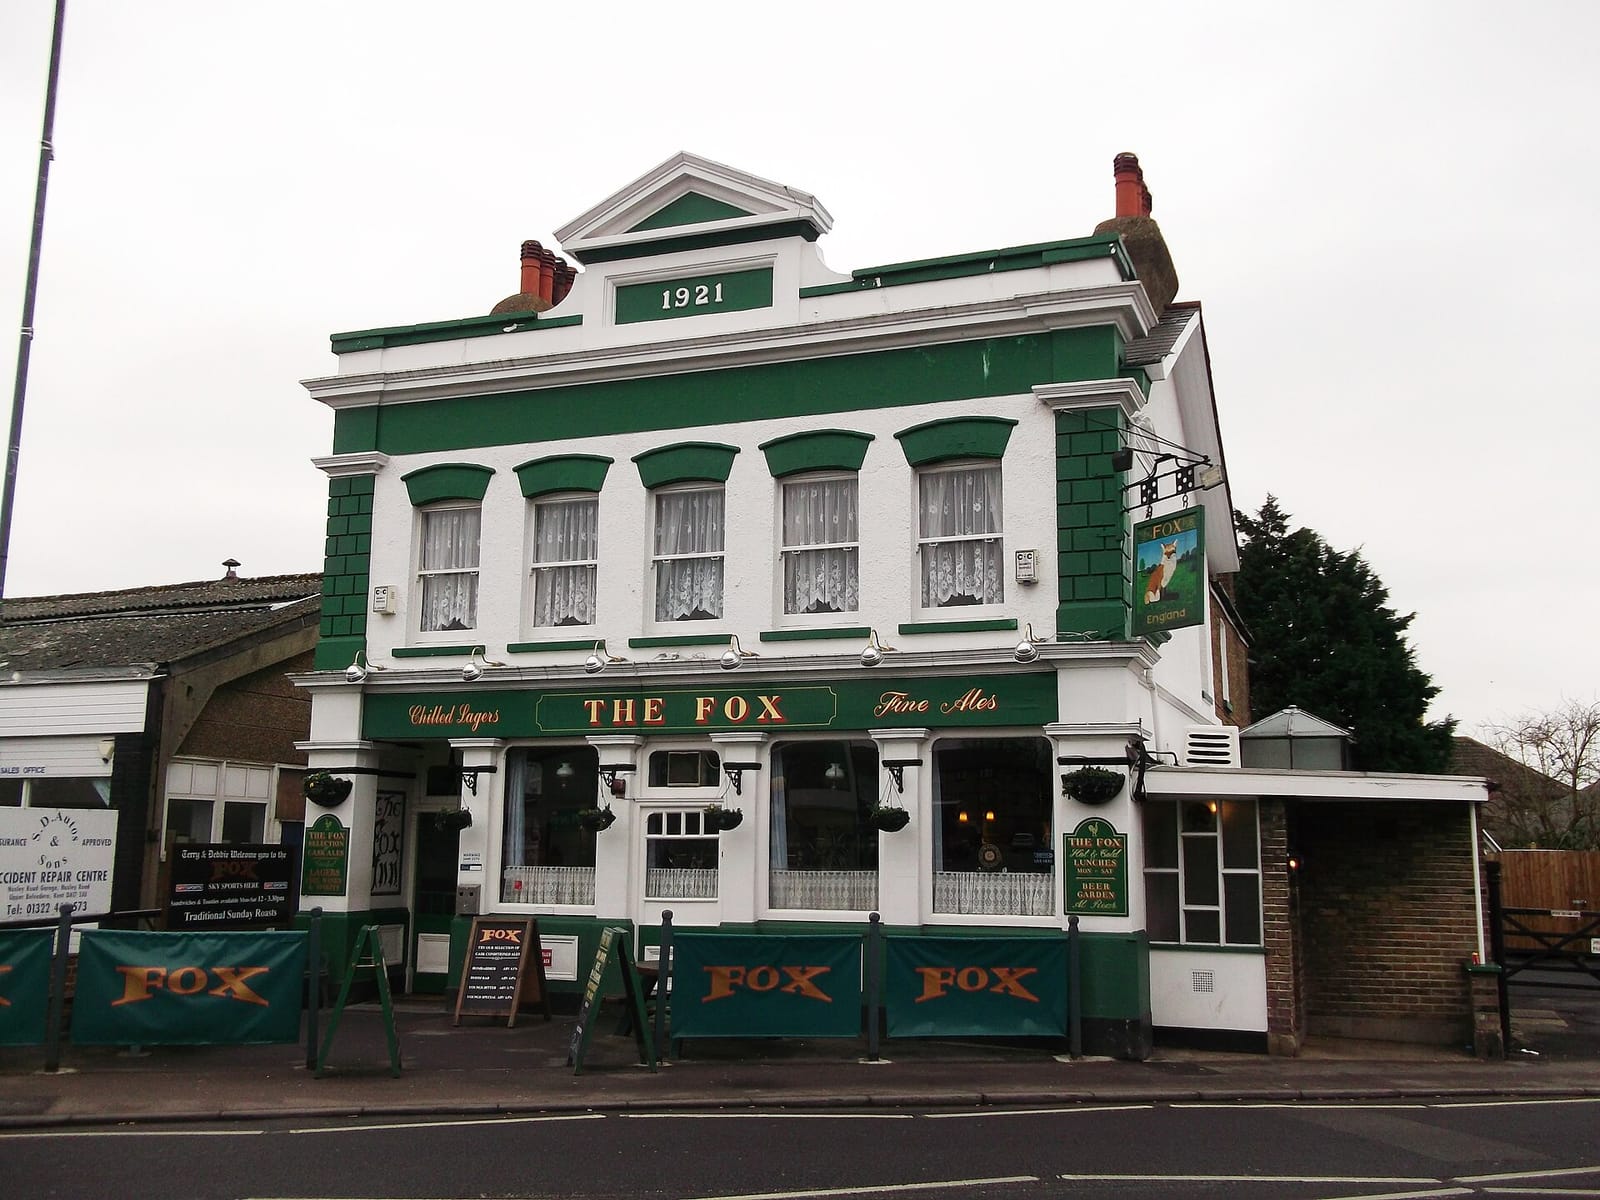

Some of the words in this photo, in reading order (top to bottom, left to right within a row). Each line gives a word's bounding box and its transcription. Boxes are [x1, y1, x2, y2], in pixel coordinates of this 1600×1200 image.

[662, 282, 723, 309] 1921
[1152, 520, 1182, 539] FOX
[1146, 608, 1186, 625] England
[873, 691, 930, 718] Fine
[940, 687, 998, 714] Ales
[408, 704, 456, 725] Chilled
[457, 703, 499, 732] Lagers
[584, 697, 665, 727] THE
[695, 695, 787, 724] FOX
[50, 835, 59, 847] &
[309, 831, 325, 840] THE
[328, 831, 346, 840] FOX
[81, 838, 112, 847] APPROVED
[1068, 837, 1092, 848] THE
[1096, 837, 1123, 848] FOX
[181, 849, 200, 860] Terry
[208, 850, 230, 859] Debbie
[230, 850, 257, 859] Welcome
[1070, 848, 1090, 858] Hot
[1090, 849, 1098, 858] &
[1100, 848, 1122, 858] Cold
[38, 854, 68, 869] Sons
[1073, 859, 1118, 867] LUNCHES
[40, 871, 72, 883] REPAIR
[76, 870, 108, 882] CENTRE
[208, 882, 220, 890] SKY
[1082, 882, 1110, 890] BEER
[1077, 890, 1116, 899] GARDEN
[7, 904, 23, 915] Tel:
[26, 903, 51, 914] 01322
[184, 910, 226, 921] Traditional
[226, 909, 253, 920] Sunday
[255, 908, 277, 917] Roasts
[480, 929, 522, 943] FOX
[111, 965, 270, 1007] FOX
[701, 965, 833, 1004] FOX
[914, 966, 1040, 1004] FOX
